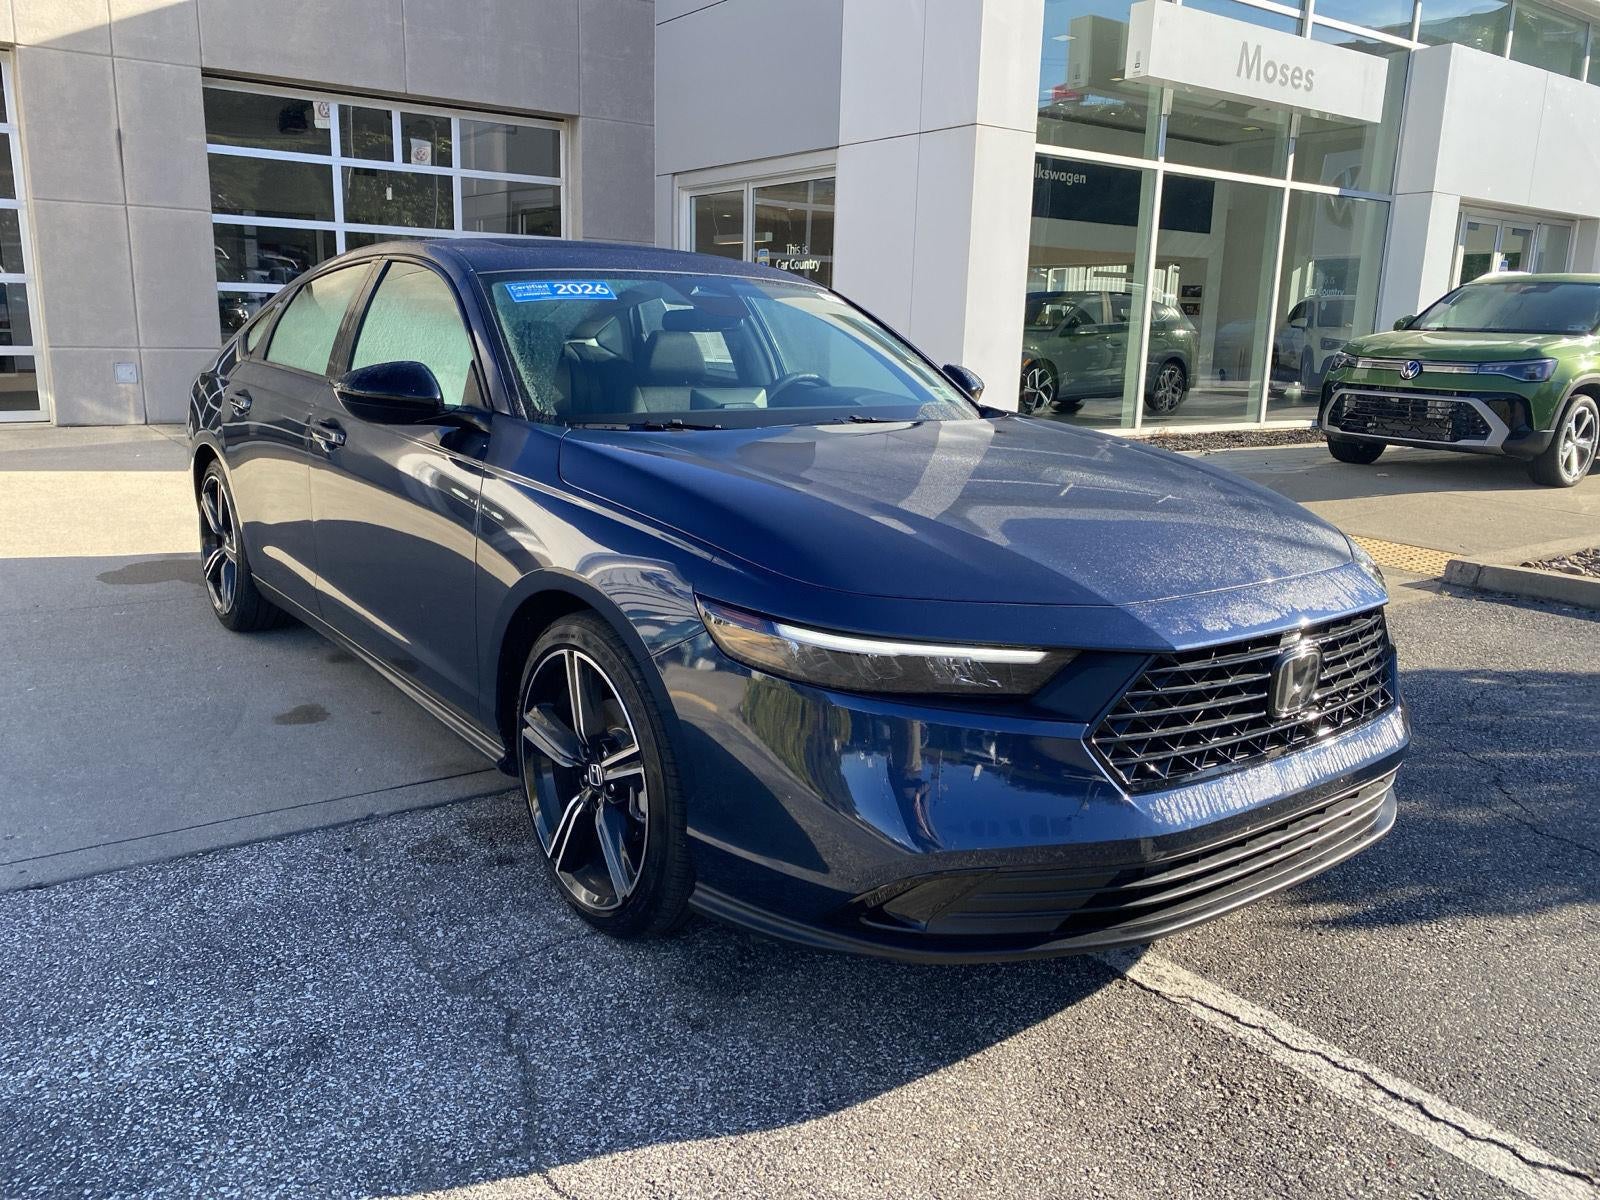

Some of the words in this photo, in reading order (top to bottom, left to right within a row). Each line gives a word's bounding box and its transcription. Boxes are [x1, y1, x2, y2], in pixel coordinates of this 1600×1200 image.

[1236, 40, 1314, 92] Moses
[786, 244, 800, 255] This
[802, 244, 809, 254] is
[776, 259, 788, 270] Car
[789, 258, 821, 272] Country
[554, 283, 609, 295] 2026
